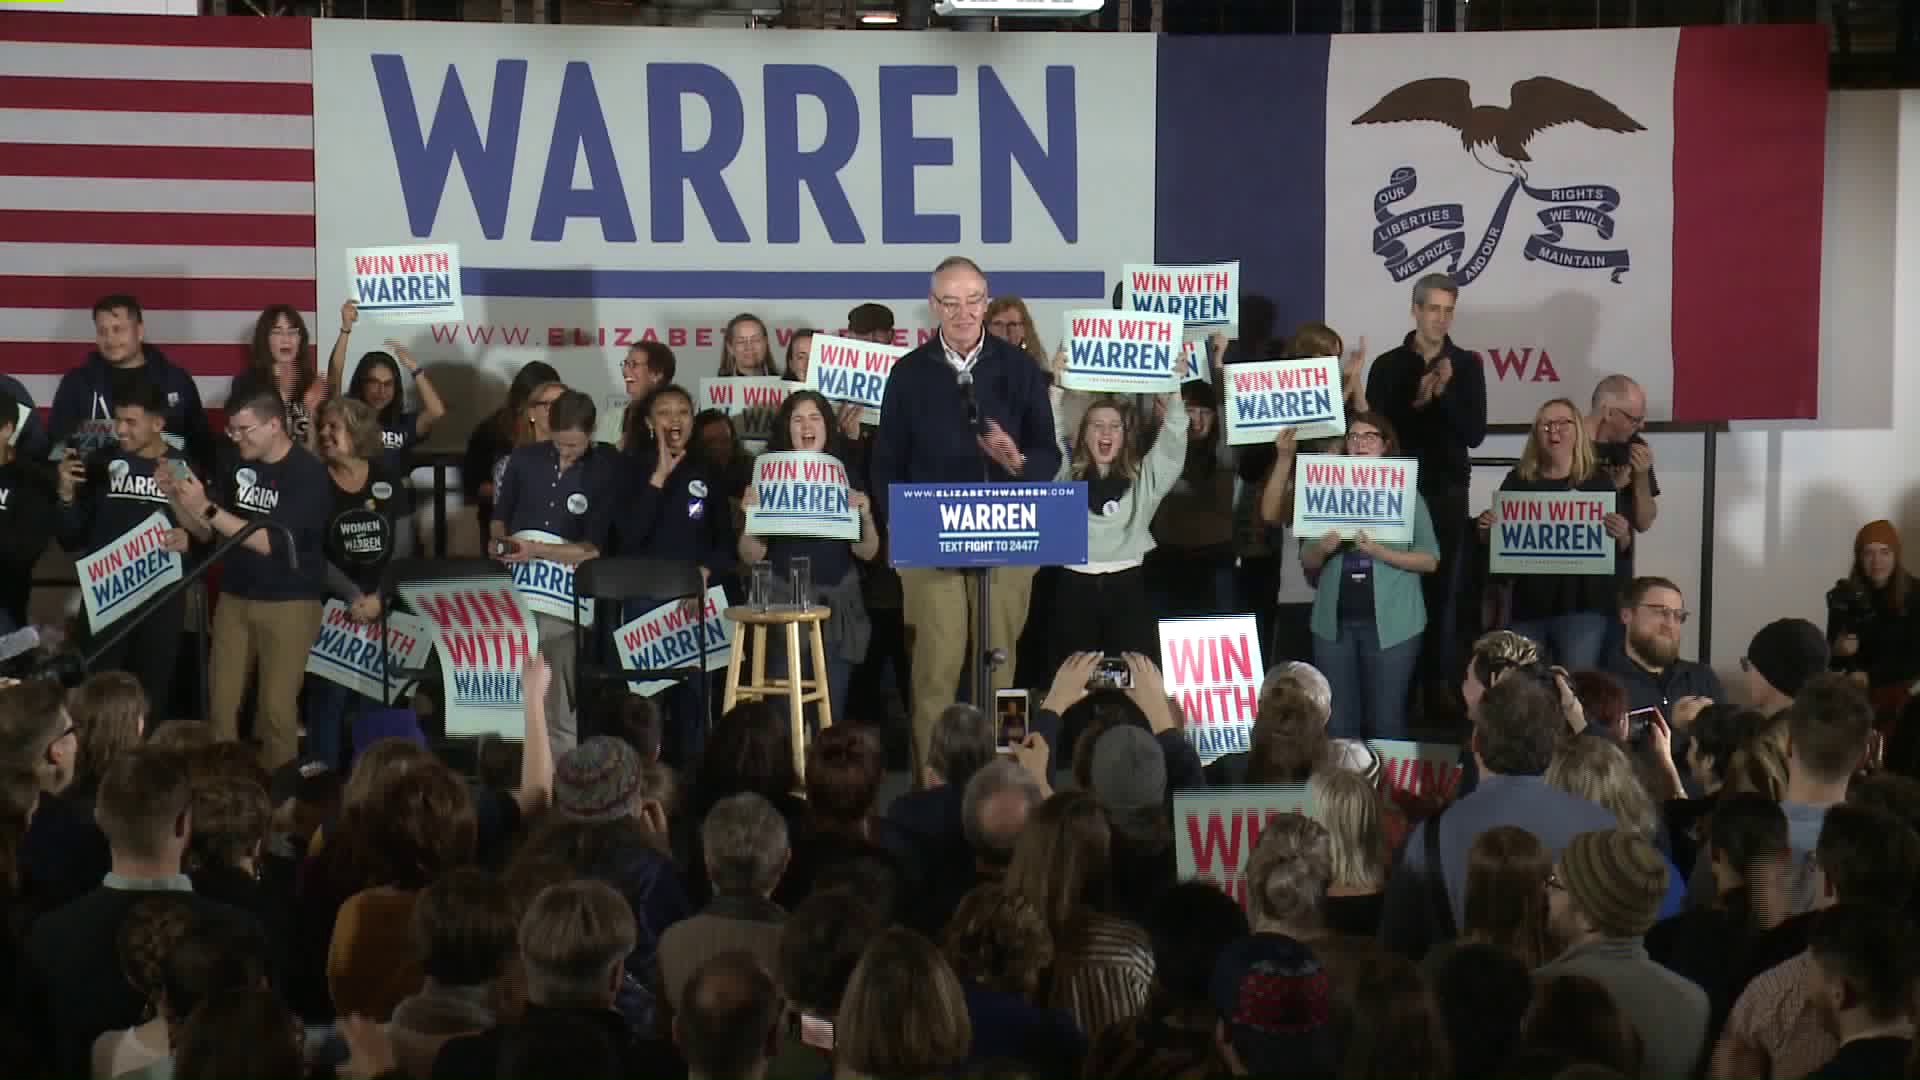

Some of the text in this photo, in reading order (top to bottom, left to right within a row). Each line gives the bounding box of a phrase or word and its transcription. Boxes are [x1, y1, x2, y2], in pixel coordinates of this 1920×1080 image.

[371, 54, 1078, 244] WARREN
[1379, 187, 1406, 203] OUR
[1551, 188, 1604, 201] RIGHTS
[1379, 209, 1450, 240] LIBERTIES
[1550, 209, 1606, 228] WE WILL
[355, 252, 449, 275] WIN WITH
[1396, 239, 1453, 278] WE PRIZE
[1466, 227, 1501, 280] AND OUR
[1538, 247, 1606, 267] MAINTAIN
[356, 273, 451, 303] WARREN
[1132, 271, 1229, 294] WIN WITH
[1132, 293, 1228, 320] WARREN
[1072, 318, 1172, 342] WIN WITH
[820, 343, 859, 369] WIN
[1071, 339, 1170, 370] WARREN
[818, 366, 882, 401] WARR
[1233, 367, 1329, 393] WIN WITH
[1234, 388, 1332, 420] WARREN
[761, 460, 848, 486] WIN WITH
[1306, 464, 1406, 489] WIN WITH
[758, 482, 848, 514] WARREN
[904, 488, 1075, 498] WWW.ELIZABETHWARREN.COM
[1305, 486, 1404, 517] WARREN
[940, 503, 1037, 531] WARREN
[1502, 500, 1604, 521] WIN WITH
[340, 519, 381, 535] WOMEN
[1501, 523, 1604, 550] WARREN
[939, 540, 1039, 552] TEXT FIGHT TO 24477
[87, 549, 123, 582] WIN
[92, 548, 170, 607] WARREN
[416, 588, 529, 672] WIN WITH
[624, 619, 661, 651] WIN
[1168, 633, 1254, 686] WIN
